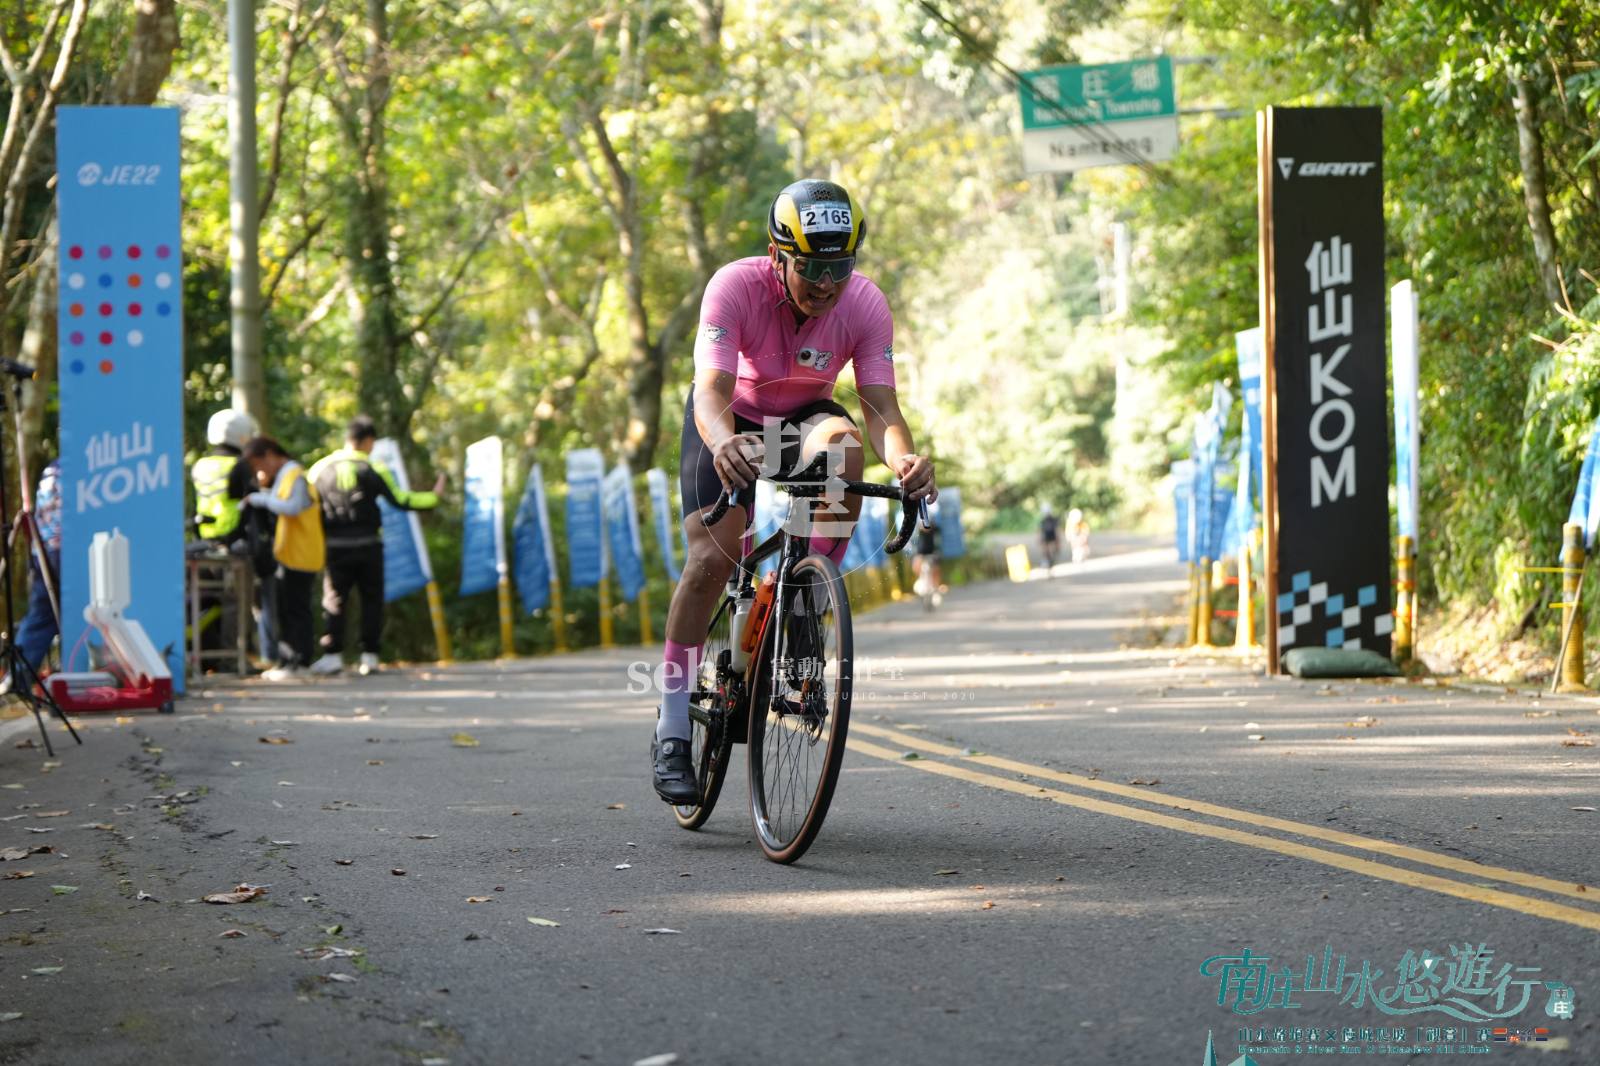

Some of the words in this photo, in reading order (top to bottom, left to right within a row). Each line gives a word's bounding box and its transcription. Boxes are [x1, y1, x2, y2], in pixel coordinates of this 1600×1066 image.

[102, 165, 161, 185] JE22
[1298, 161, 1376, 177] GIANT
[805, 209, 851, 226] 2165
[84, 421, 153, 473] 仙山
[76, 452, 169, 513] KOM
